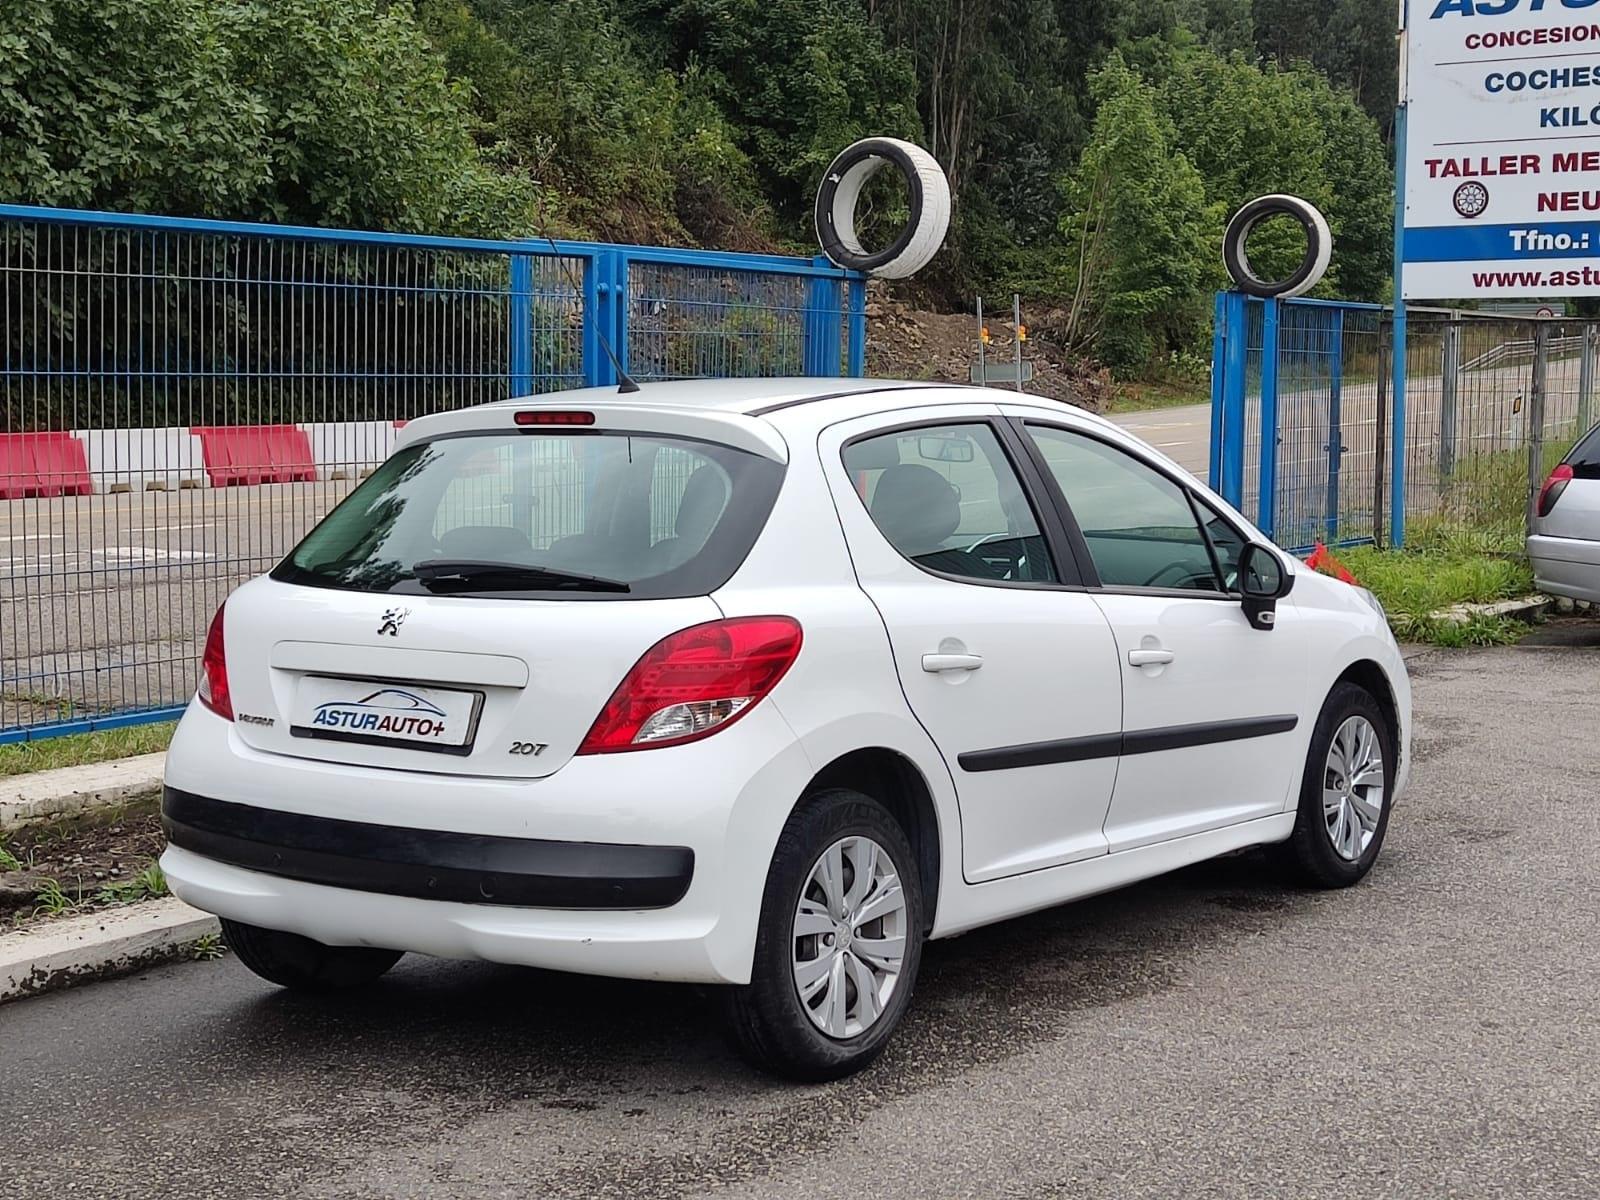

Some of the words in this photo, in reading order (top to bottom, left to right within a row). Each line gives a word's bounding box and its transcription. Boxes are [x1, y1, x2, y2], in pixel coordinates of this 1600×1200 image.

[1424, 154, 1541, 178] TALLER
[1552, 152, 1600, 172] ME
[1537, 190, 1600, 212] NEU
[1509, 229, 1589, 251] Tfno.:
[509, 741, 549, 756] 207
